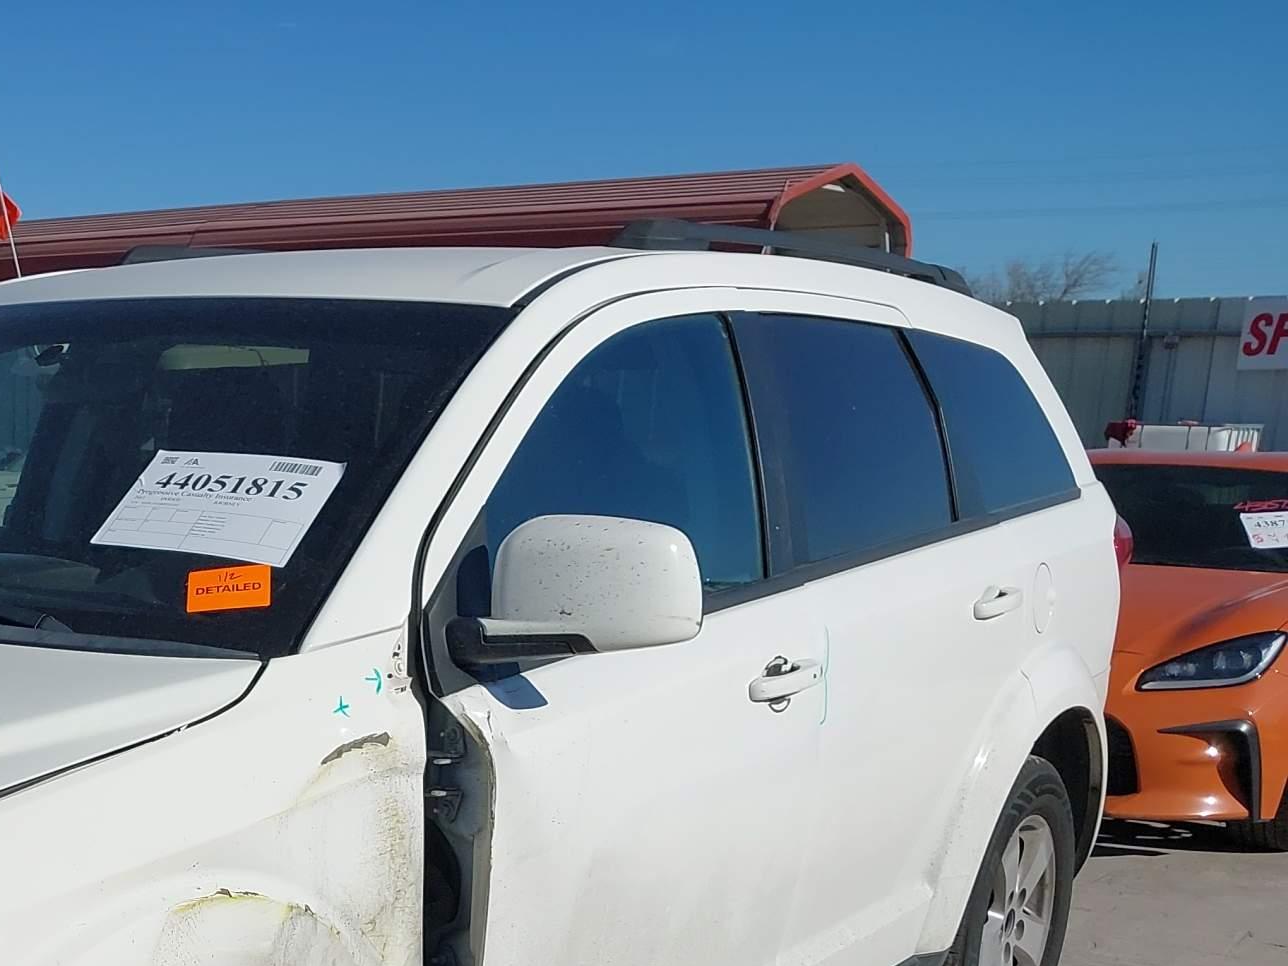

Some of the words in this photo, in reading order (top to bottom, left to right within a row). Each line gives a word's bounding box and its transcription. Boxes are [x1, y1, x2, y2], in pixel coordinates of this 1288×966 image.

[155, 472, 309, 500] 44051815
[137, 489, 180, 497] Progressive
[181, 490, 213, 500] Casualty
[214, 493, 253, 503] Insurance
[195, 582, 262, 597] DETAILED
